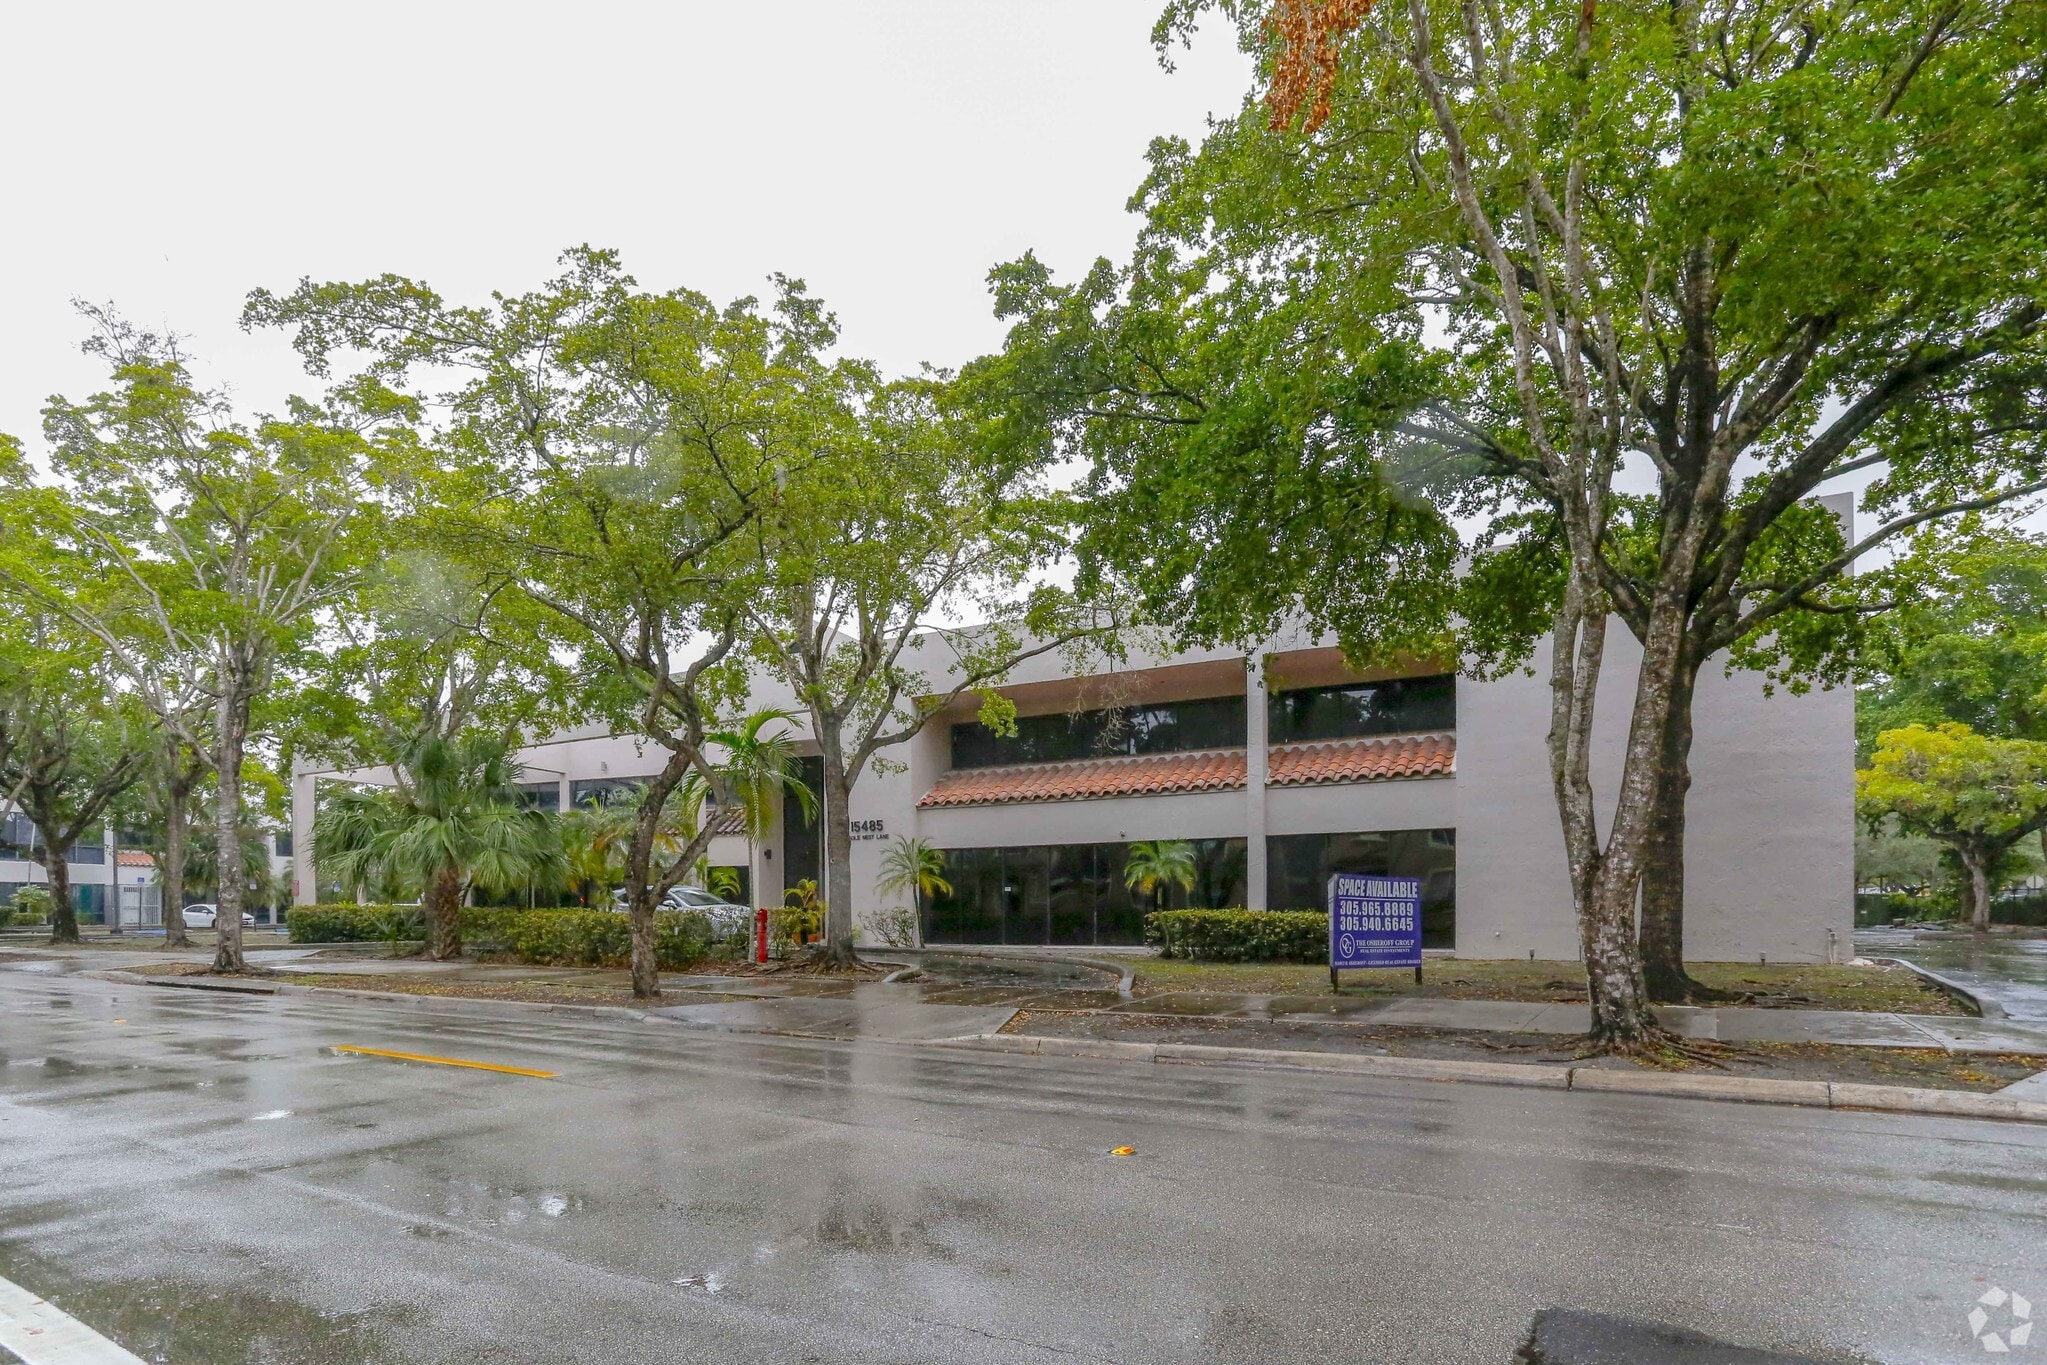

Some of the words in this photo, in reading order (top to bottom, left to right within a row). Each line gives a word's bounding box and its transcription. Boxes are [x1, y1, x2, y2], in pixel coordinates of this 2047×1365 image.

[850, 820, 884, 832] 15485
[1338, 878, 1366, 897] SPACE
[1366, 880, 1418, 898] AVAILABLE
[1340, 900, 1414, 916] 305.965.8889
[1340, 916, 1414, 931] 305.940.6645
